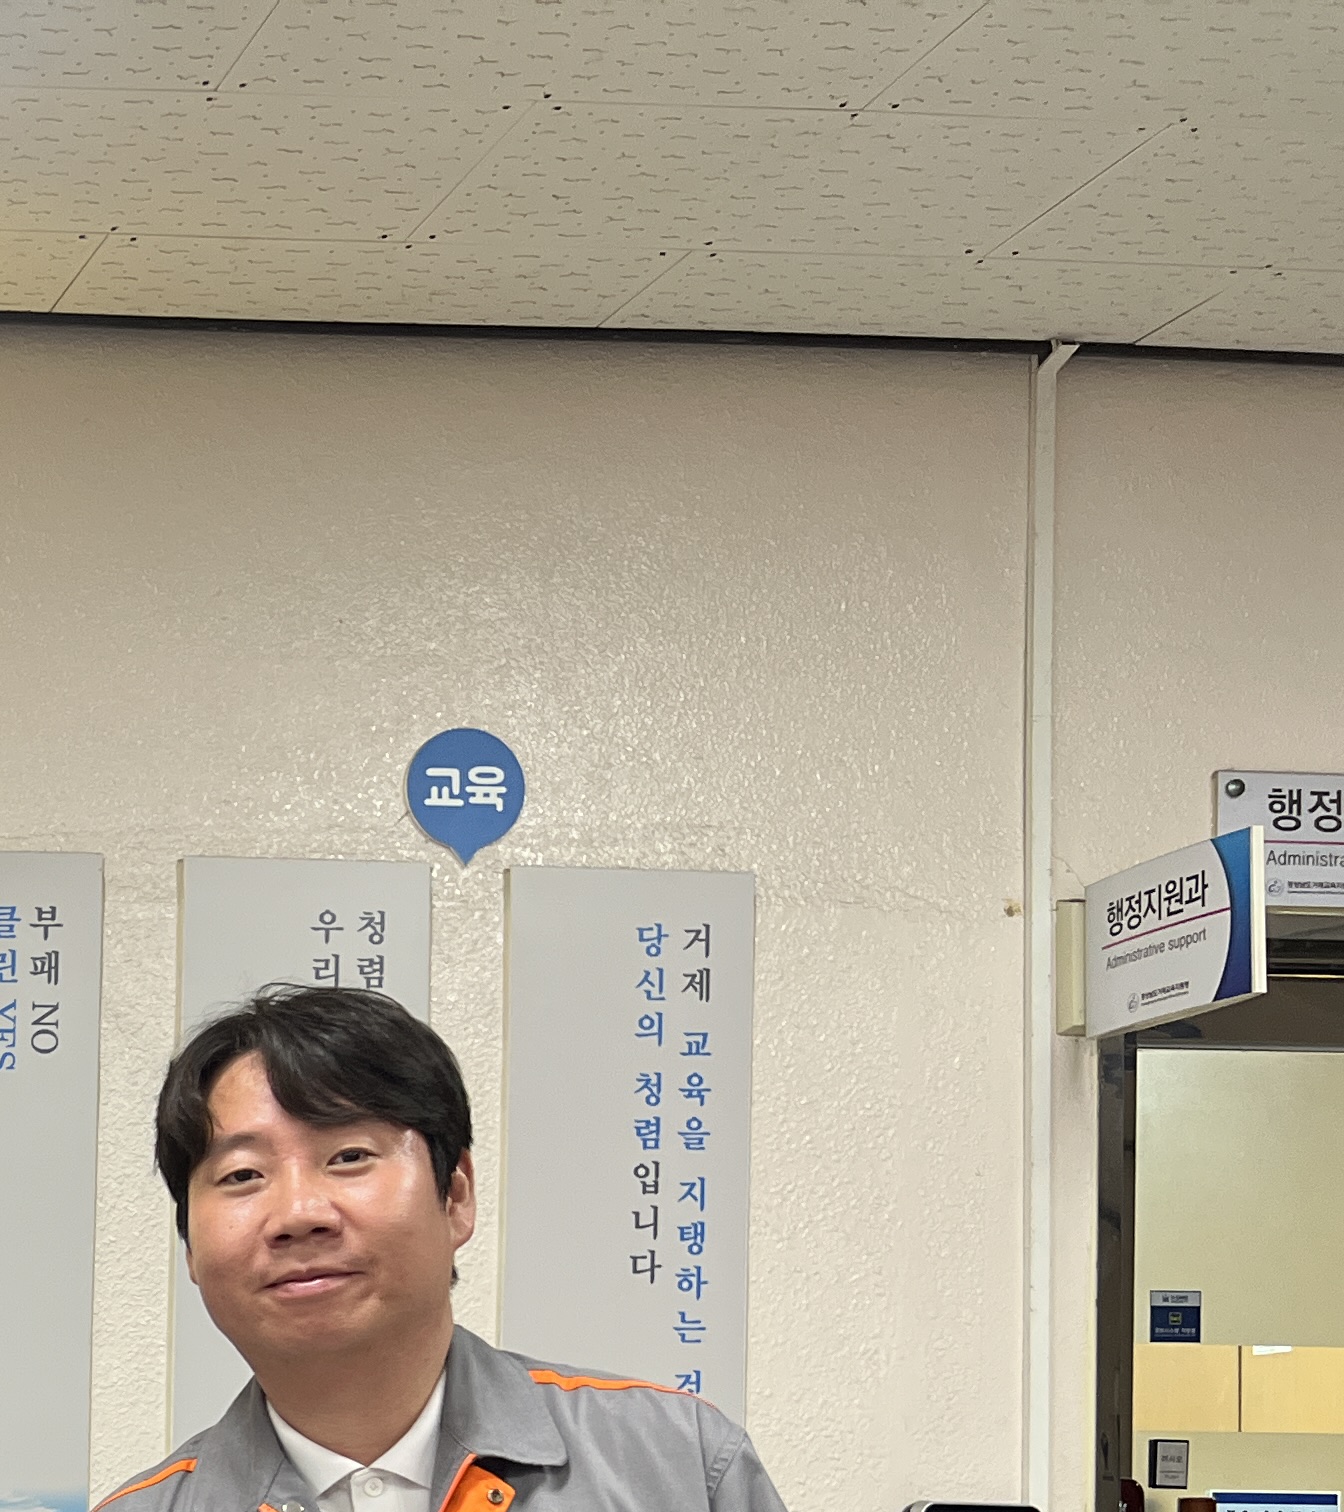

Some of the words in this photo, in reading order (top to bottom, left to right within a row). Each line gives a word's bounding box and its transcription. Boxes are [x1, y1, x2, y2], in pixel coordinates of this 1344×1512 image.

[424, 766, 507, 812] 교육
[1268, 788, 1342, 832] 행정
[1107, 870, 1208, 936] 행정지원과
[29, 906, 63, 985] 부패
[310, 909, 344, 988] 우리
[356, 910, 386, 988] 청렴
[634, 923, 669, 1046] 당신의
[682, 923, 711, 1002] 거제
[1106, 942, 1165, 971] Administrative
[1168, 927, 1206, 951] support
[30, 1001, 59, 1054] NO
[678, 1032, 711, 1150] 교육을
[630, 1072, 663, 1284] 청렴입니다
[673, 1176, 708, 1343] 지탱하는
